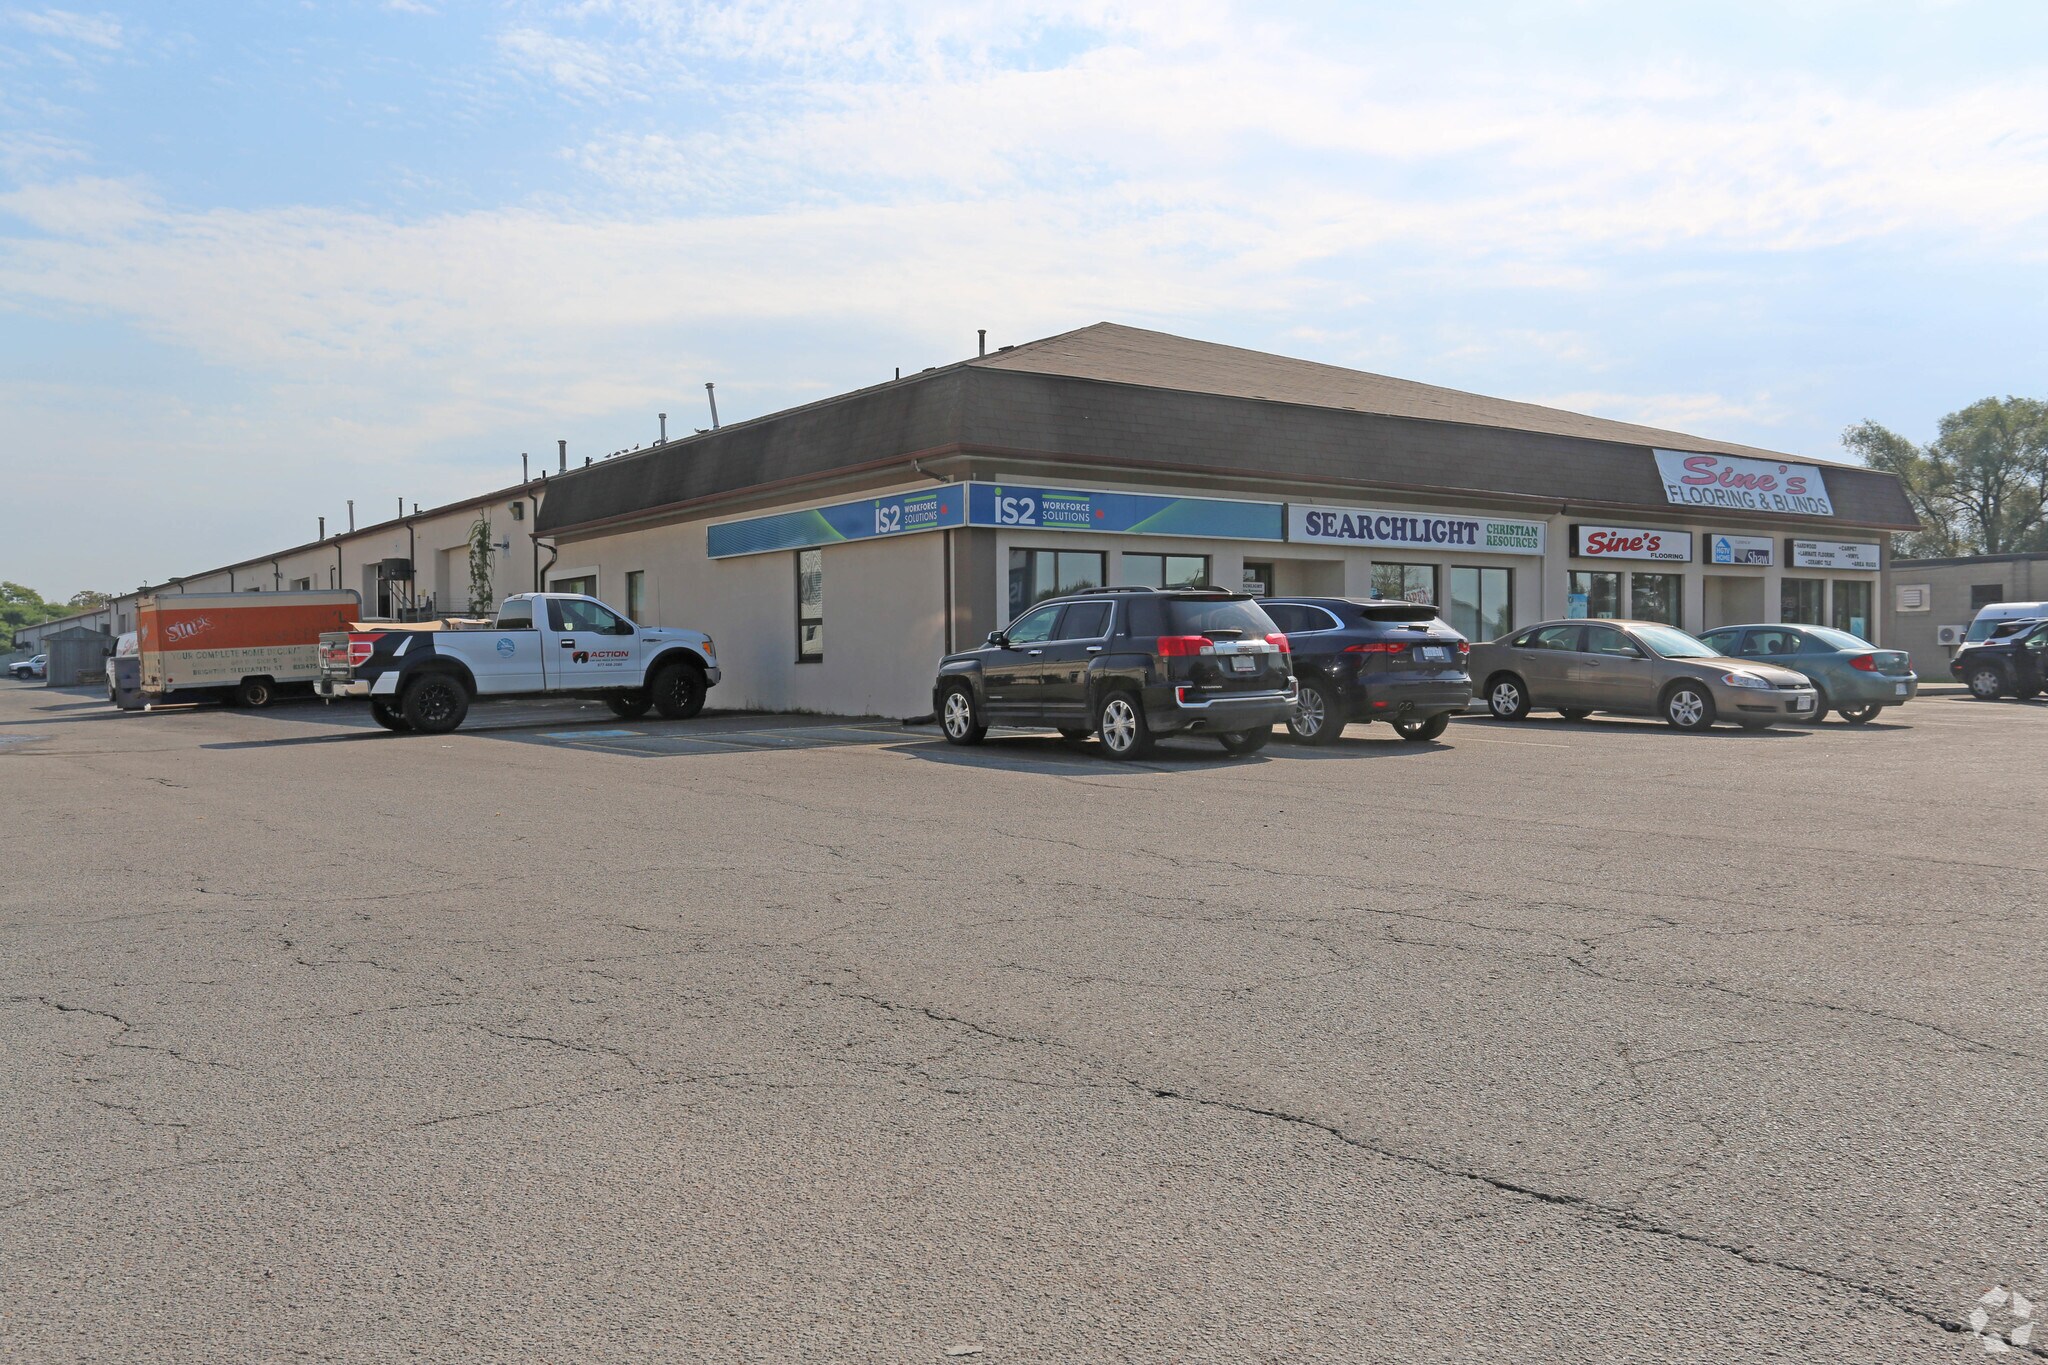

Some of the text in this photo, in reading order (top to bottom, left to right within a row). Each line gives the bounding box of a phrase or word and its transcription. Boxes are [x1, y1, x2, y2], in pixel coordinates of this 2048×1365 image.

[1681, 456, 1807, 495] Sine's
[1667, 484, 1829, 514] FLOORING & BLINDS
[904, 501, 937, 513] WORKFORCE
[1042, 501, 1090, 512] WORKFORCE
[904, 511, 938, 524] SOLUTIONS
[1042, 511, 1090, 522] SOLUTIONS
[1305, 511, 1480, 545] SEARCHLIGHT
[1486, 523, 1538, 537] CHRISTIAN
[1486, 535, 1538, 549] RESOURCES
[1586, 531, 1662, 555] Sine's
[1650, 552, 1684, 560] FLOORING
[1747, 550, 1769, 564] Shaw
